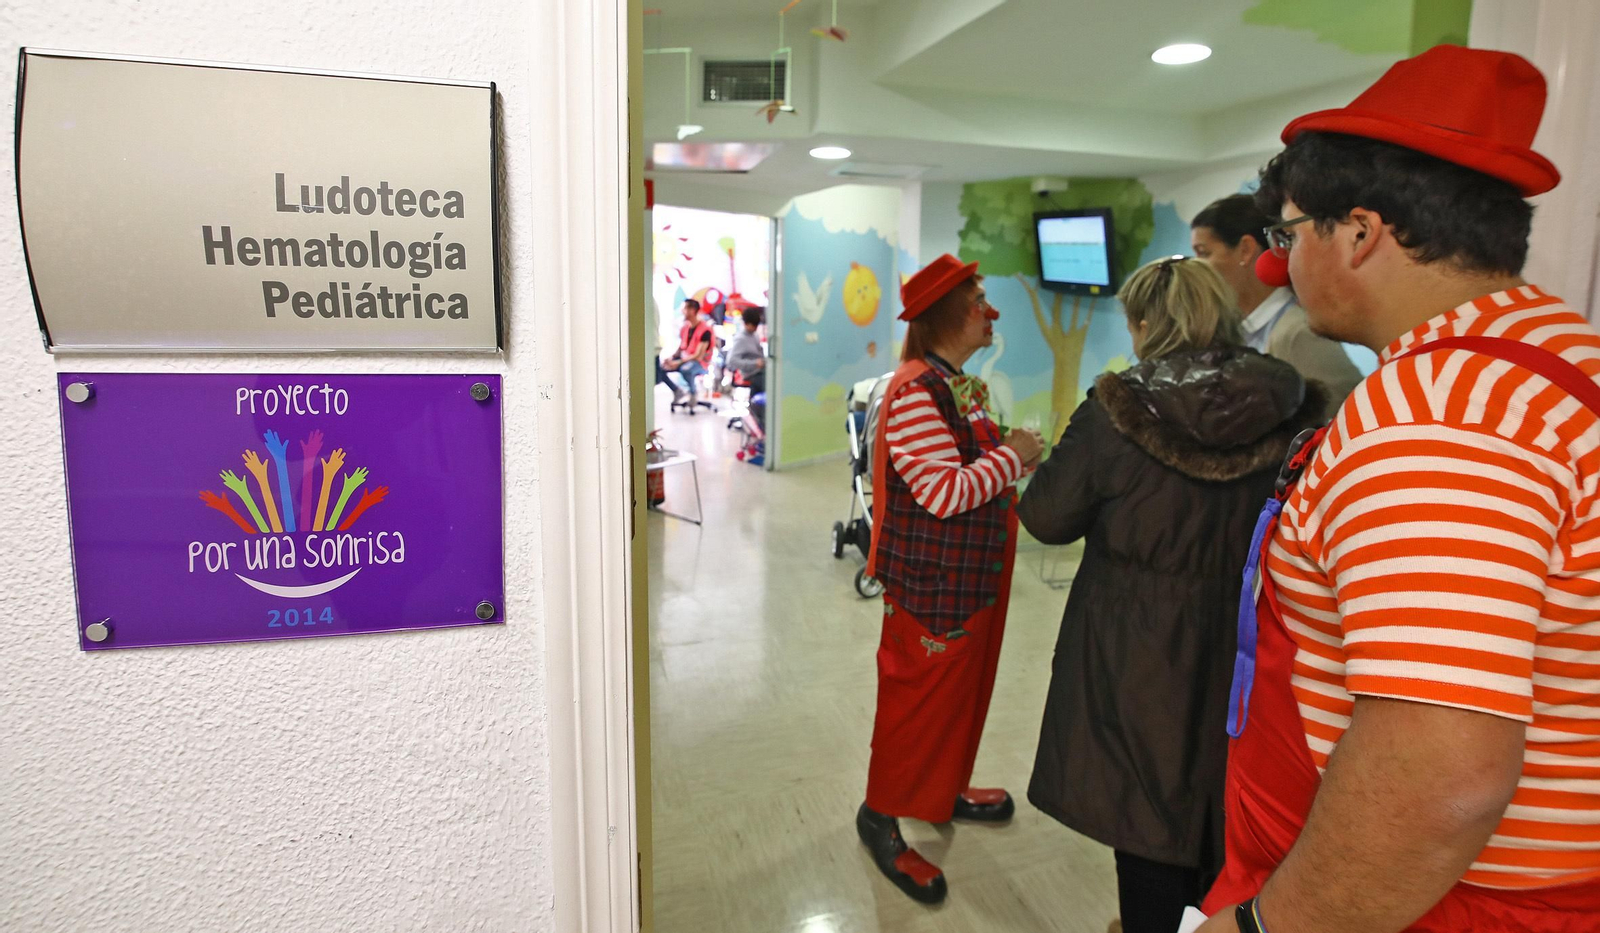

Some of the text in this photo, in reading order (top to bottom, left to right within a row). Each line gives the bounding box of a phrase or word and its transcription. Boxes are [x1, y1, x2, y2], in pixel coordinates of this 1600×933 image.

[274, 172, 465, 219] Ludoteca
[202, 225, 467, 279] Hematología
[261, 280, 469, 320] Pediátrica
[244, 535, 296, 571] una
[267, 606, 334, 628] 2014
